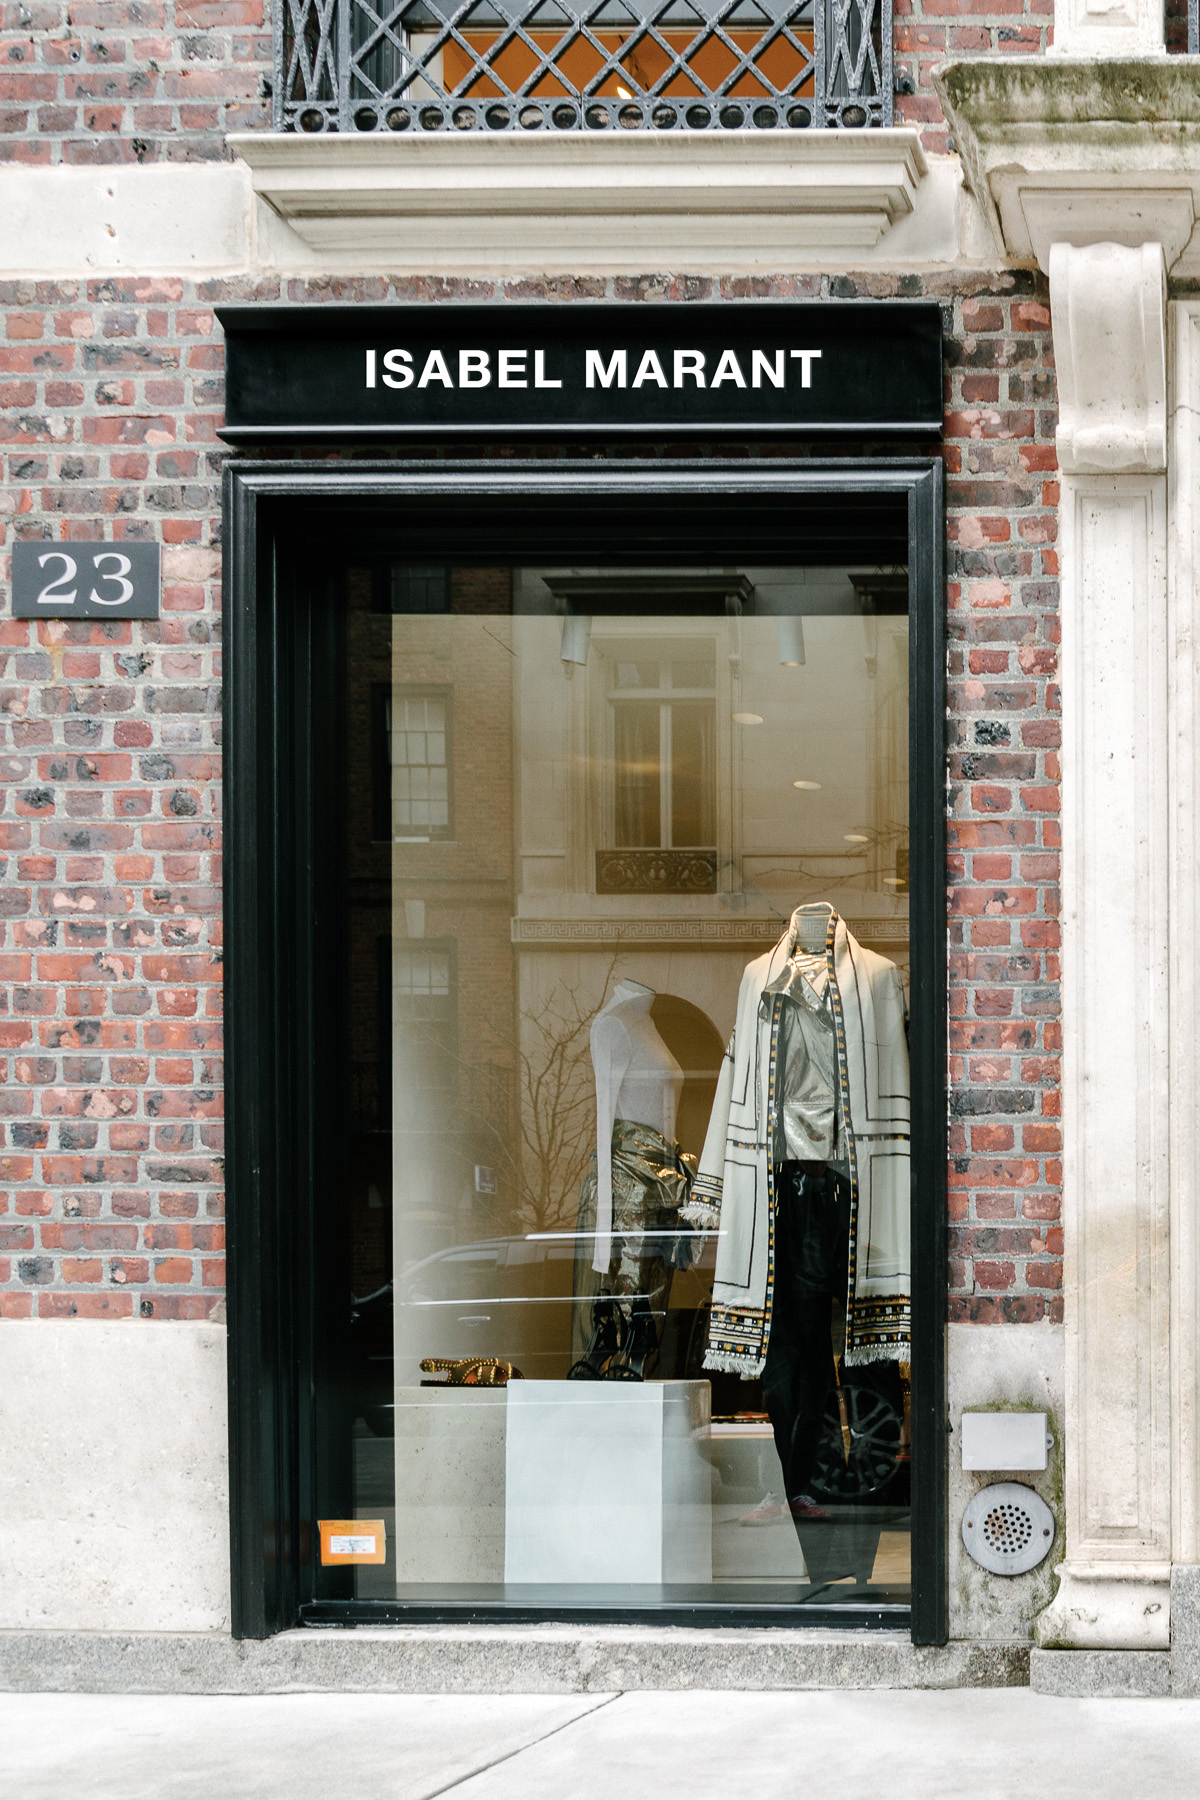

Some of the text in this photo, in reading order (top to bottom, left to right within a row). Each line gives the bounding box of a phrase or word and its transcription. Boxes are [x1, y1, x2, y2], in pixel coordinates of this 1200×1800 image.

[365, 348, 822, 389] ISABEL MARANT
[37, 552, 134, 606] 23
